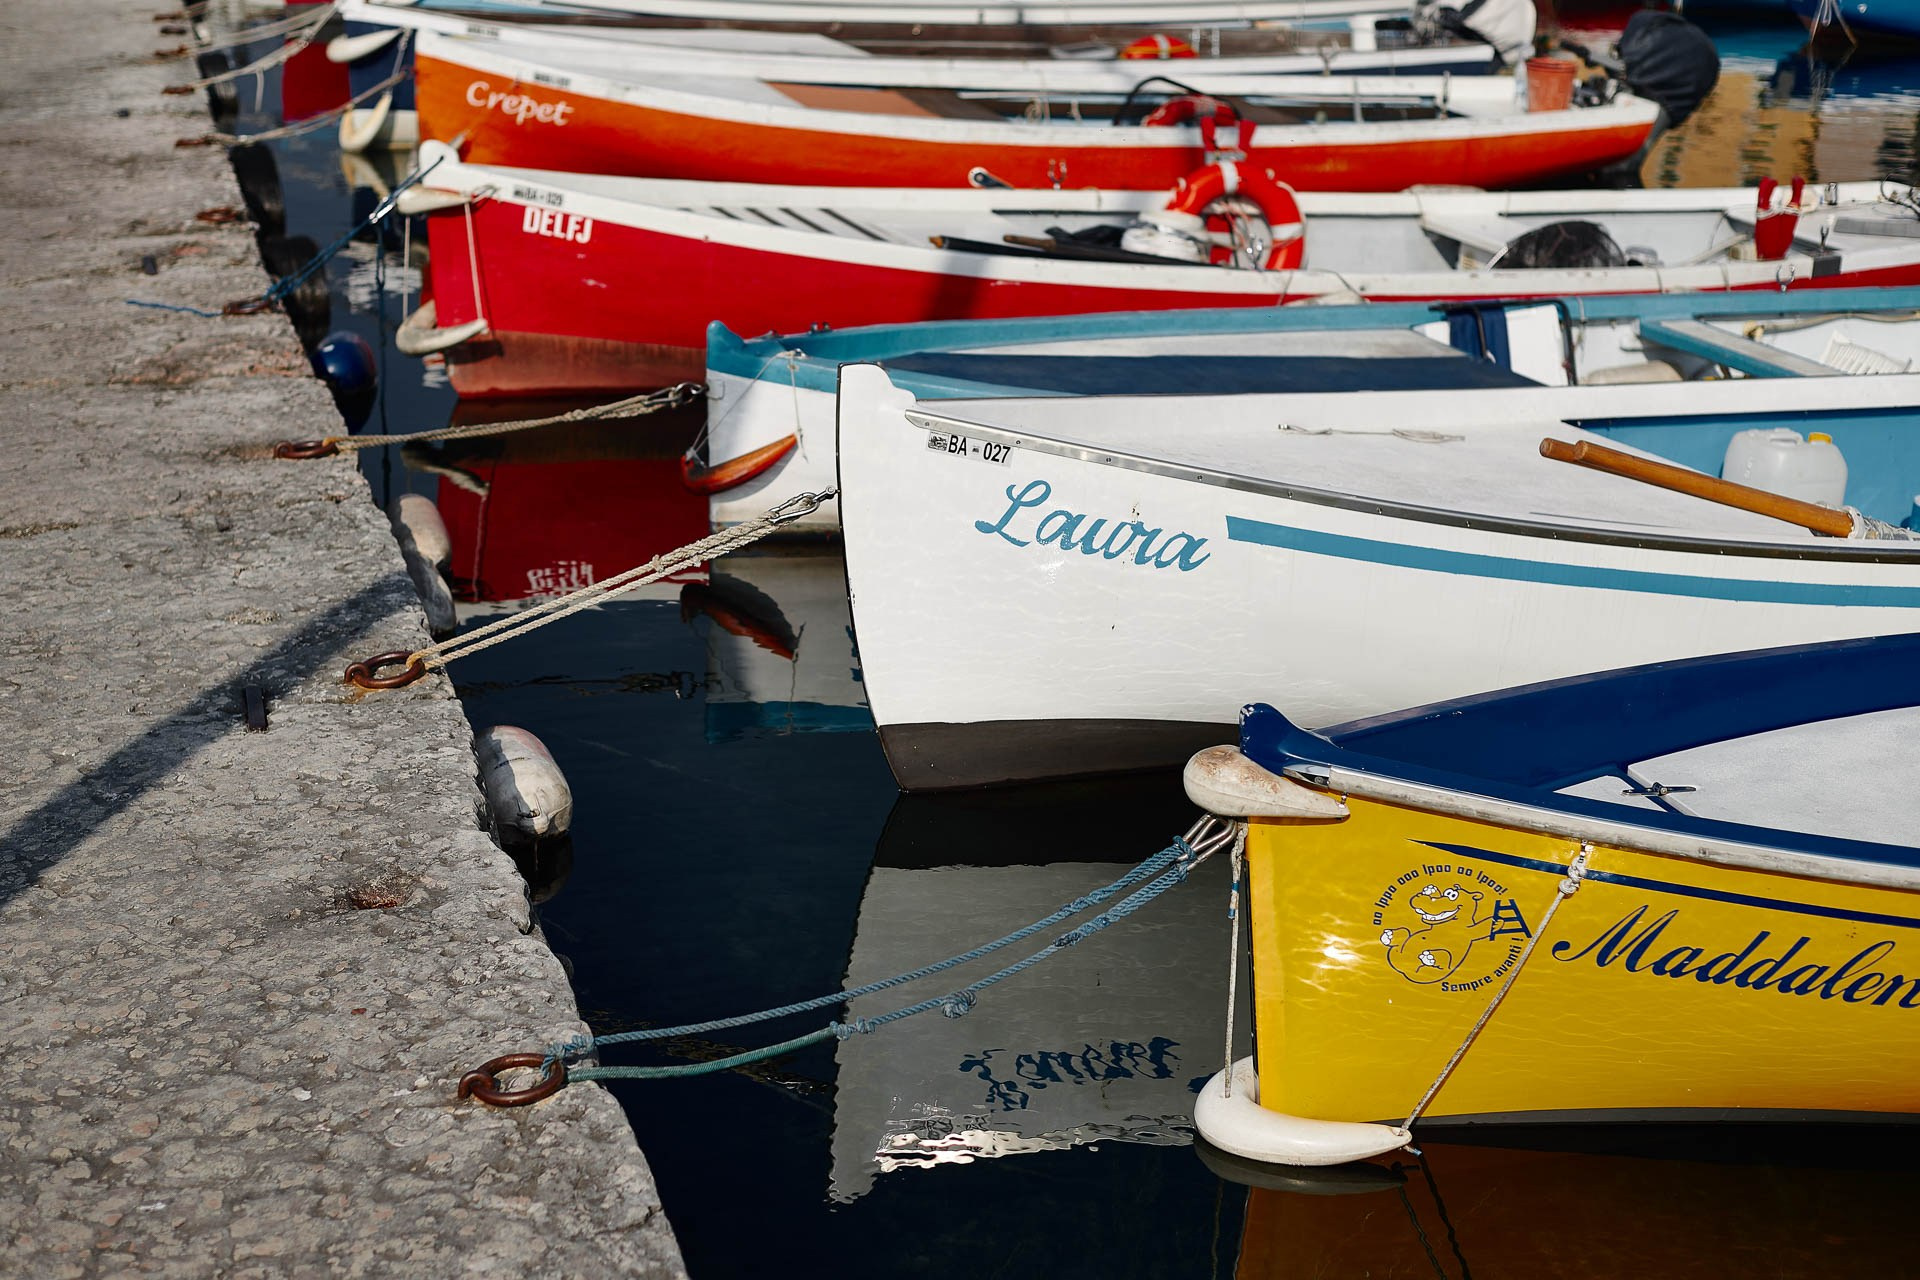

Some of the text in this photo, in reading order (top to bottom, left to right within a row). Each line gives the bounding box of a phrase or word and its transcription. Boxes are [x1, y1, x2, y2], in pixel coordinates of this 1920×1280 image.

[466, 81, 575, 126] Crepet
[948, 434, 967, 456] BA
[983, 442, 1011, 463] 027
[974, 480, 1211, 572] Laura
[1441, 975, 1493, 992] Sempre
